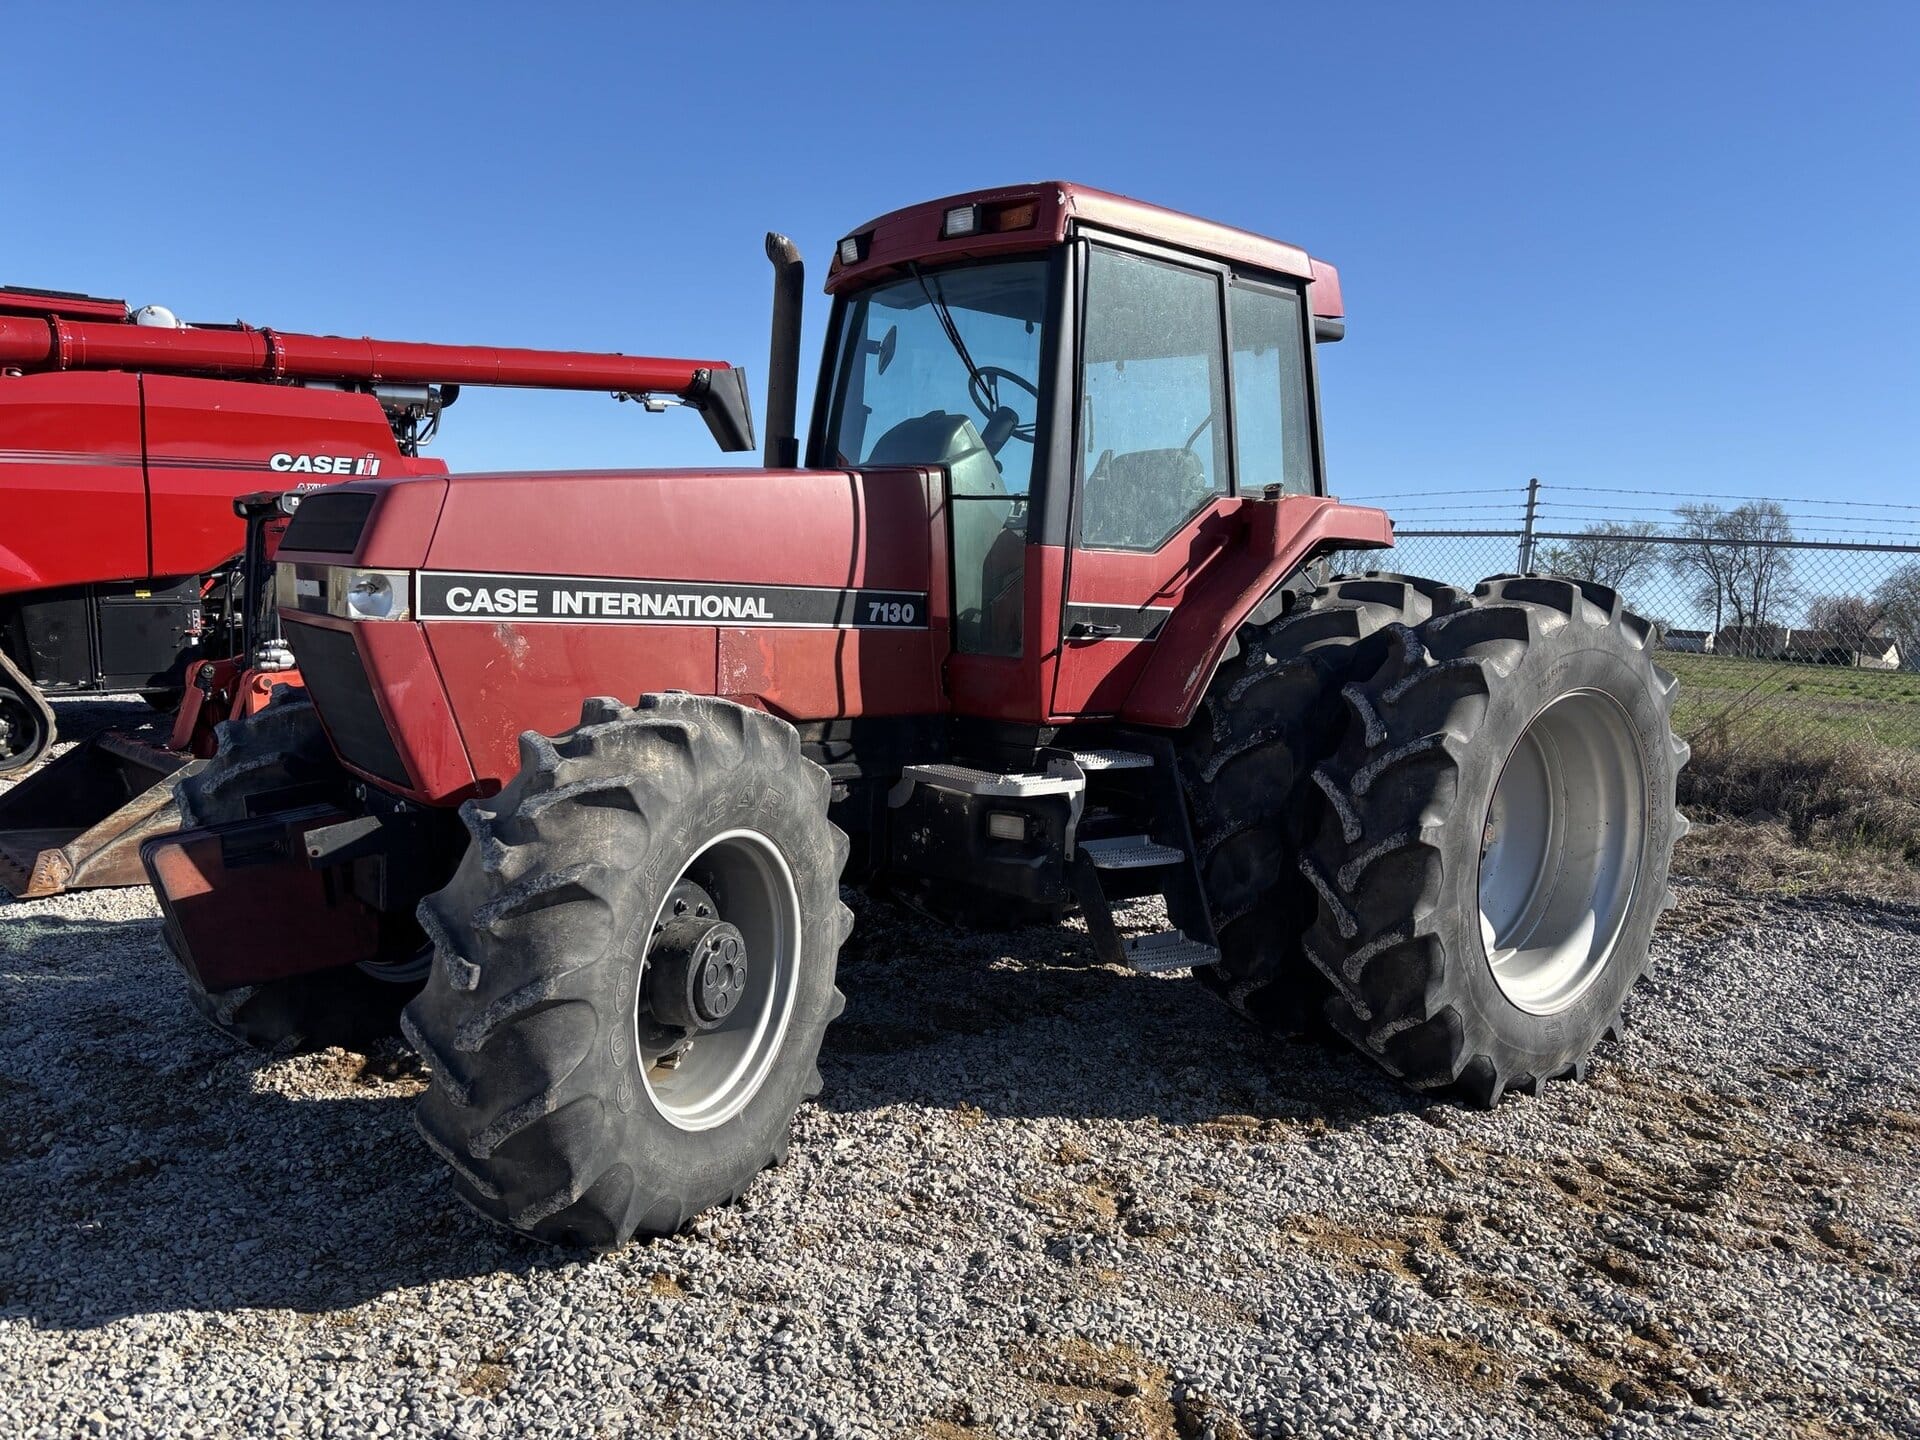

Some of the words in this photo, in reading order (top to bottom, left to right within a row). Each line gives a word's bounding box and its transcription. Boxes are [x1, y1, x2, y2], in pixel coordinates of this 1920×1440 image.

[270, 453, 353, 475] CASE
[446, 586, 539, 614] CASE
[552, 590, 774, 619] INTERNATIONAL
[868, 602, 915, 623] 7130
